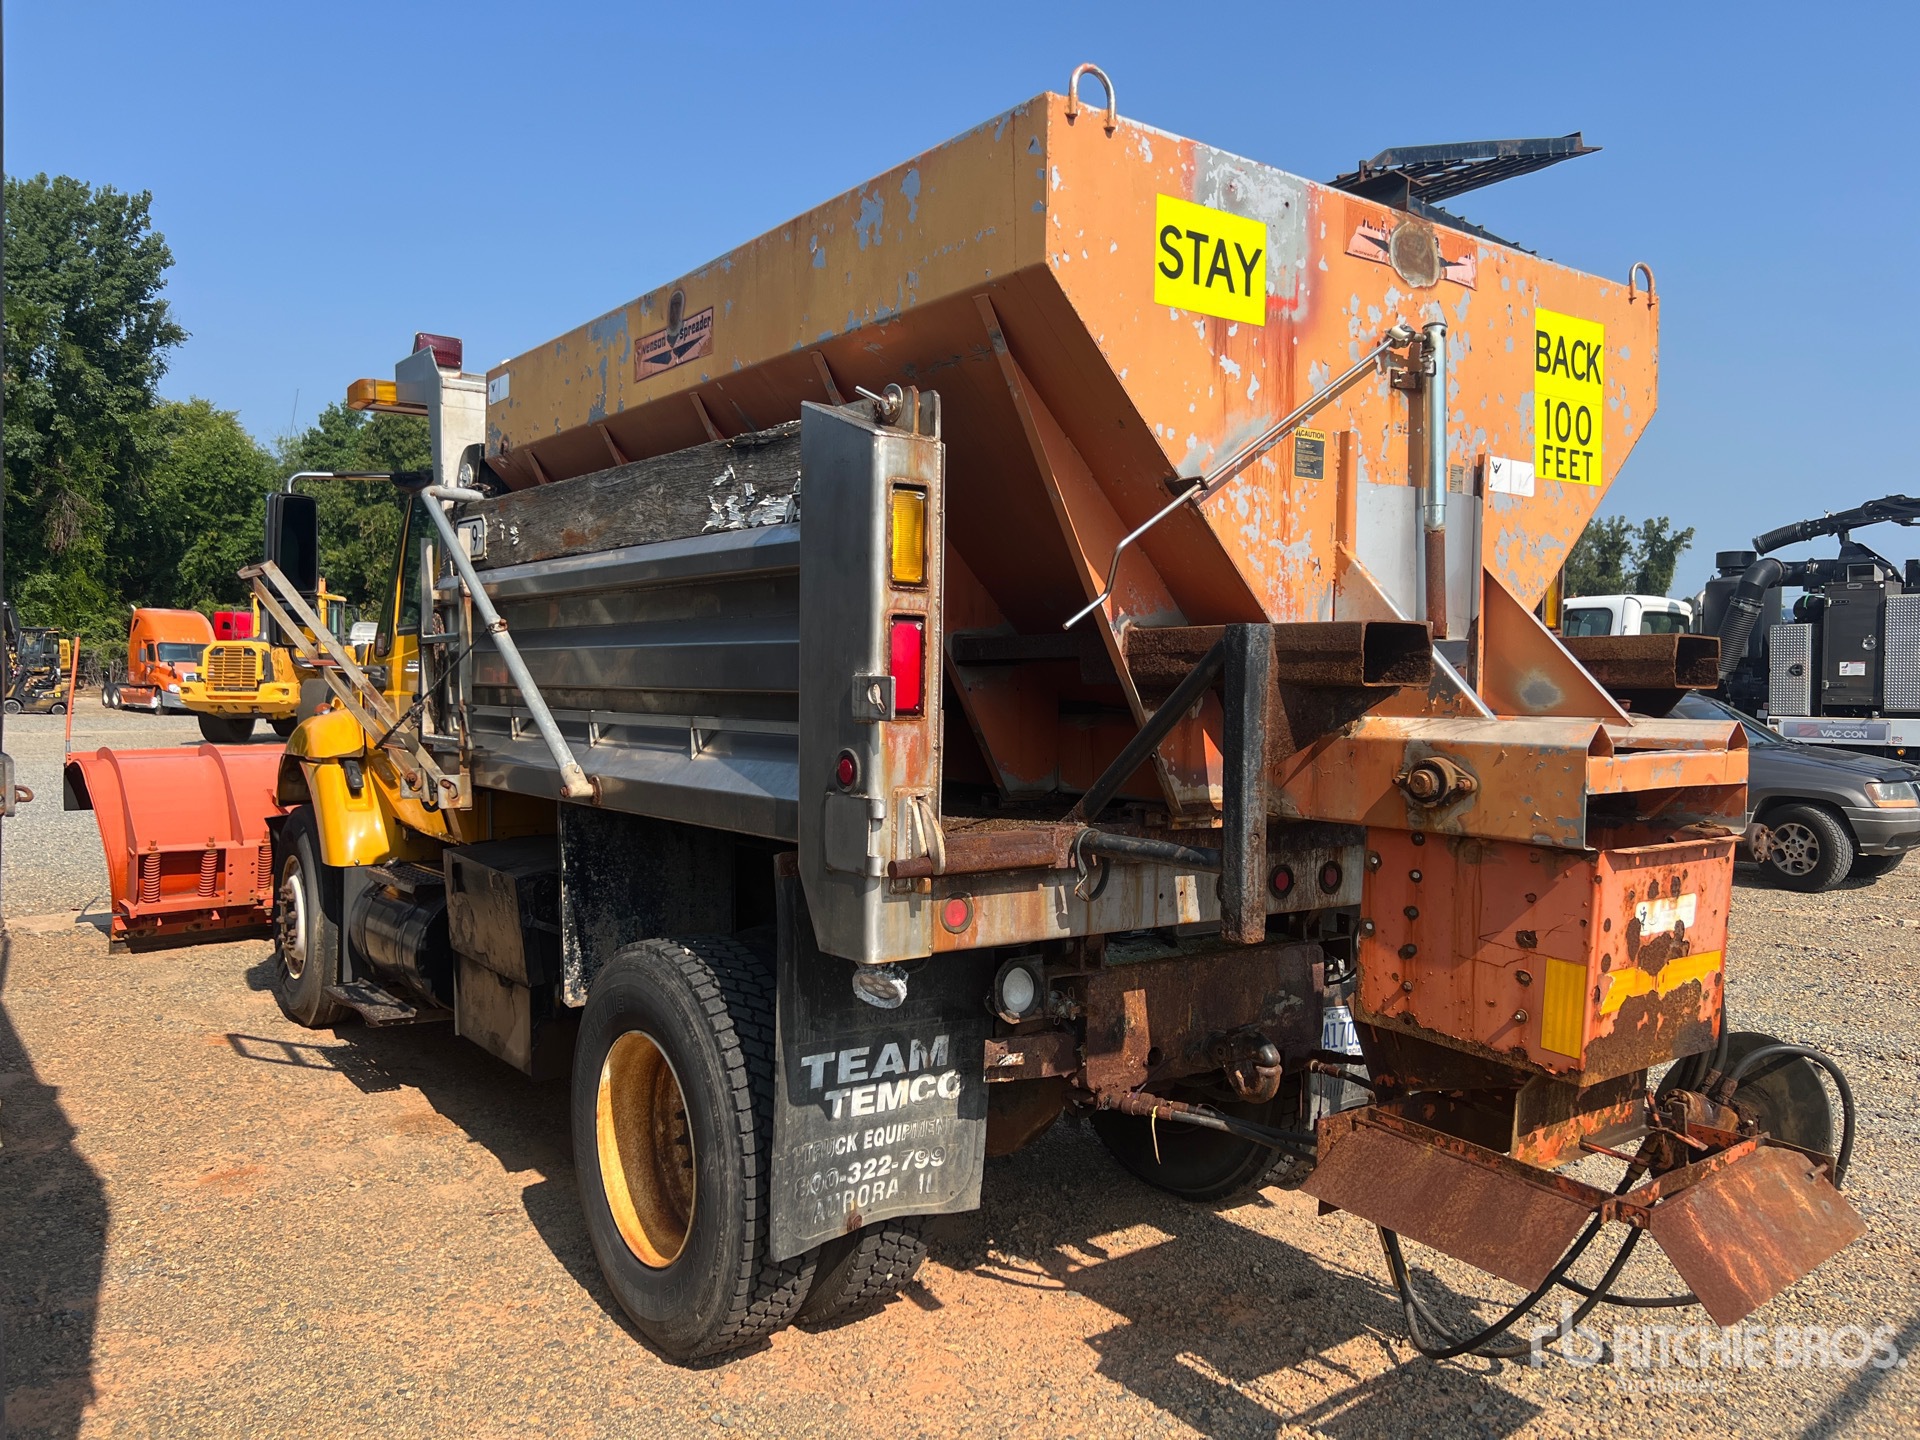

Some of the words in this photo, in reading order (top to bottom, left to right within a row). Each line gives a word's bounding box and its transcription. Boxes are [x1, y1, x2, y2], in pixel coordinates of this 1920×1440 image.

[1158, 225, 1263, 297] STAY
[1536, 330, 1602, 385] BACK
[1301, 429, 1325, 440] CAUTION
[1545, 398, 1592, 446] 100
[1543, 444, 1593, 482] FEET
[800, 1034, 950, 1090] TEAM
[824, 1069, 964, 1120] TEMCO
[801, 1132, 859, 1163] TRUCK
[863, 1114, 957, 1150] EQUIPMENT
